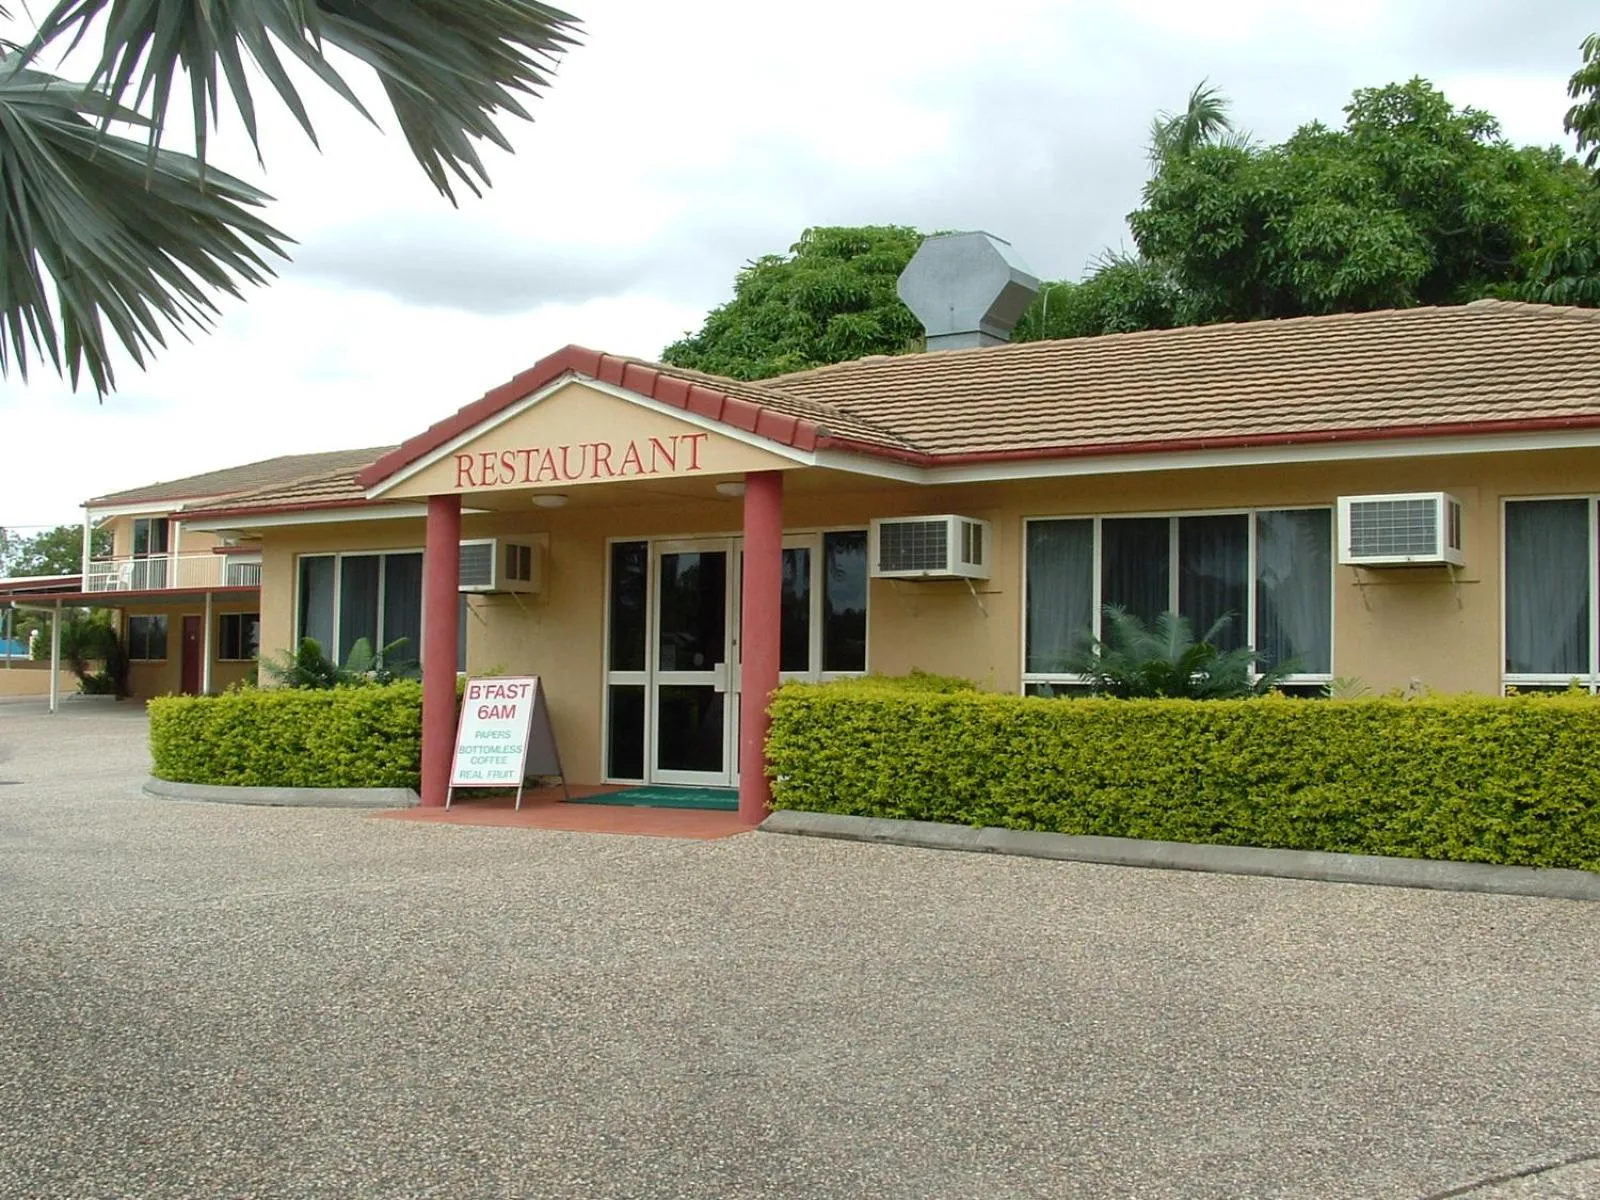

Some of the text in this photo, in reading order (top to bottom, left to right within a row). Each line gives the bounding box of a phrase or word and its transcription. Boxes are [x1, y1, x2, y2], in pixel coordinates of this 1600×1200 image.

[454, 433, 708, 488] RESTAURANT
[469, 684, 530, 700] B'FAST
[477, 705, 516, 720] 6AM
[475, 730, 511, 739] PAPERS
[458, 745, 522, 754] BOTTOMLESS
[470, 756, 507, 765] COFFEE
[459, 770, 514, 779] REAL FRUIT
